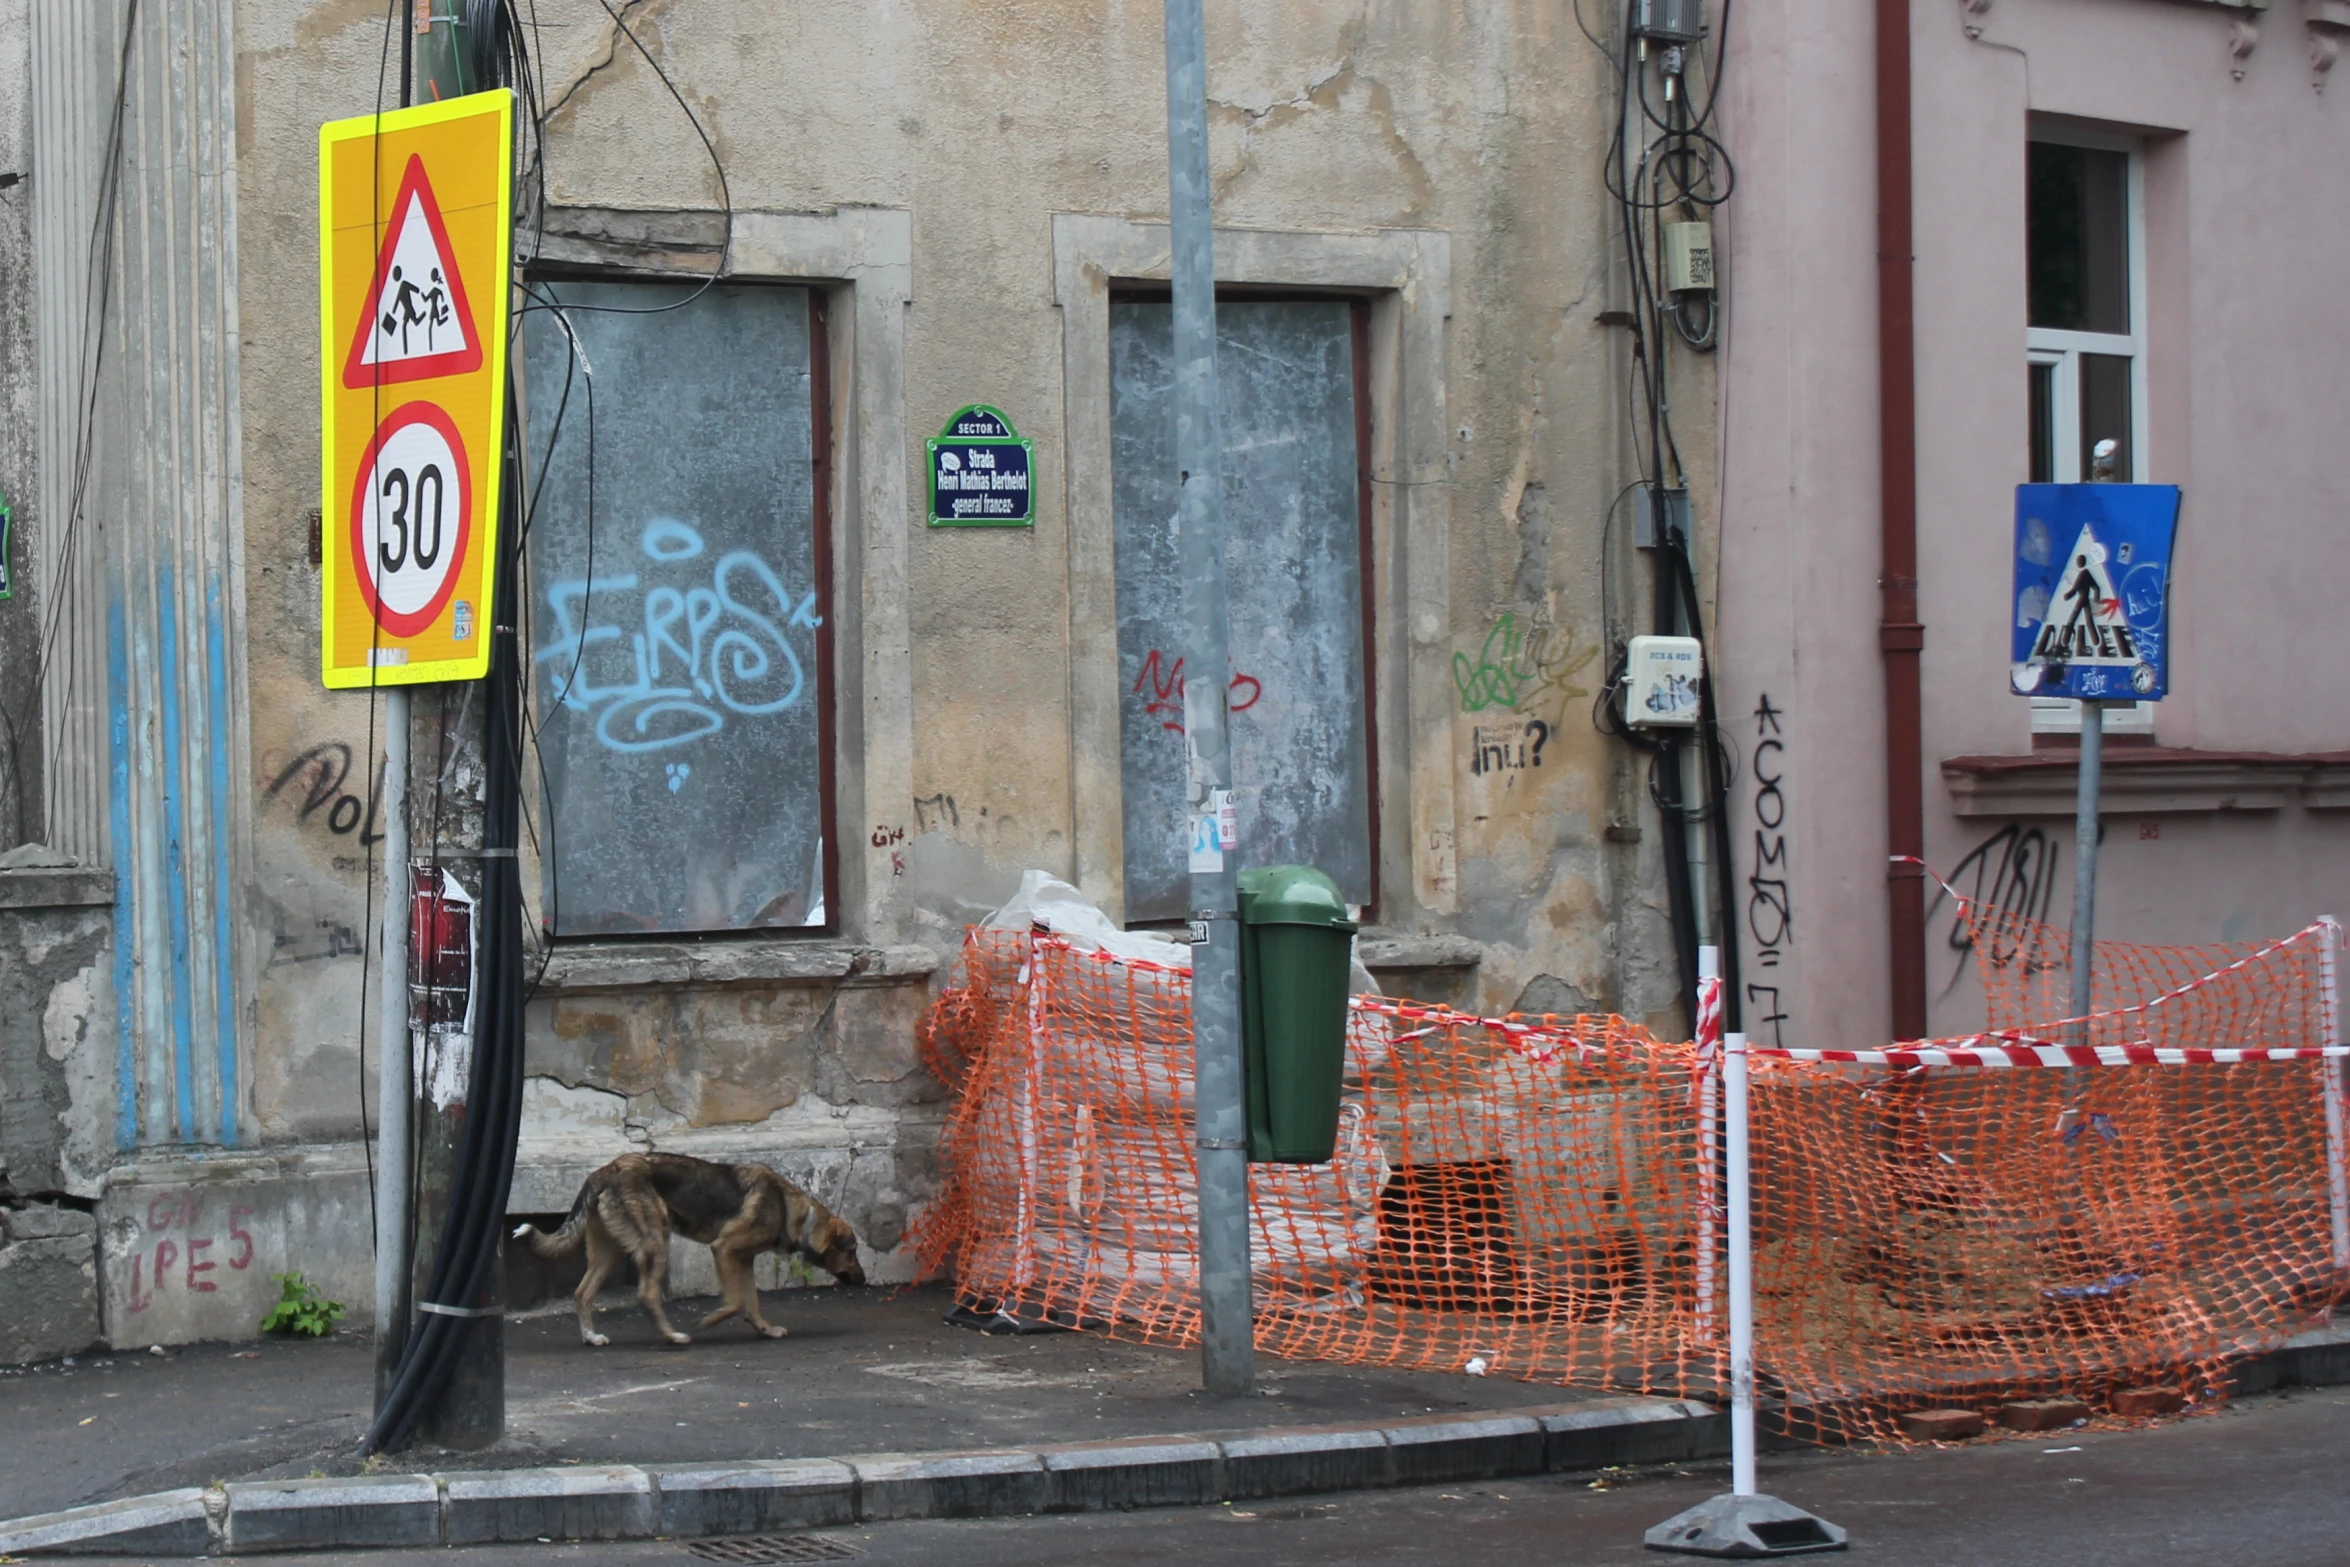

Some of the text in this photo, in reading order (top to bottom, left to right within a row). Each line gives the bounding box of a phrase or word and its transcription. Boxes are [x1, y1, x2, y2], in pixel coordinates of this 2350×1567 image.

[958, 423, 1001, 434] SECTOR 1
[968, 448, 995, 468] Strada
[937, 470, 1027, 490] Henri Mathias Berthelot
[380, 463, 443, 573] 30
[1649, 651, 1665, 660] RCS
[1675, 652, 1692, 661] RDS
